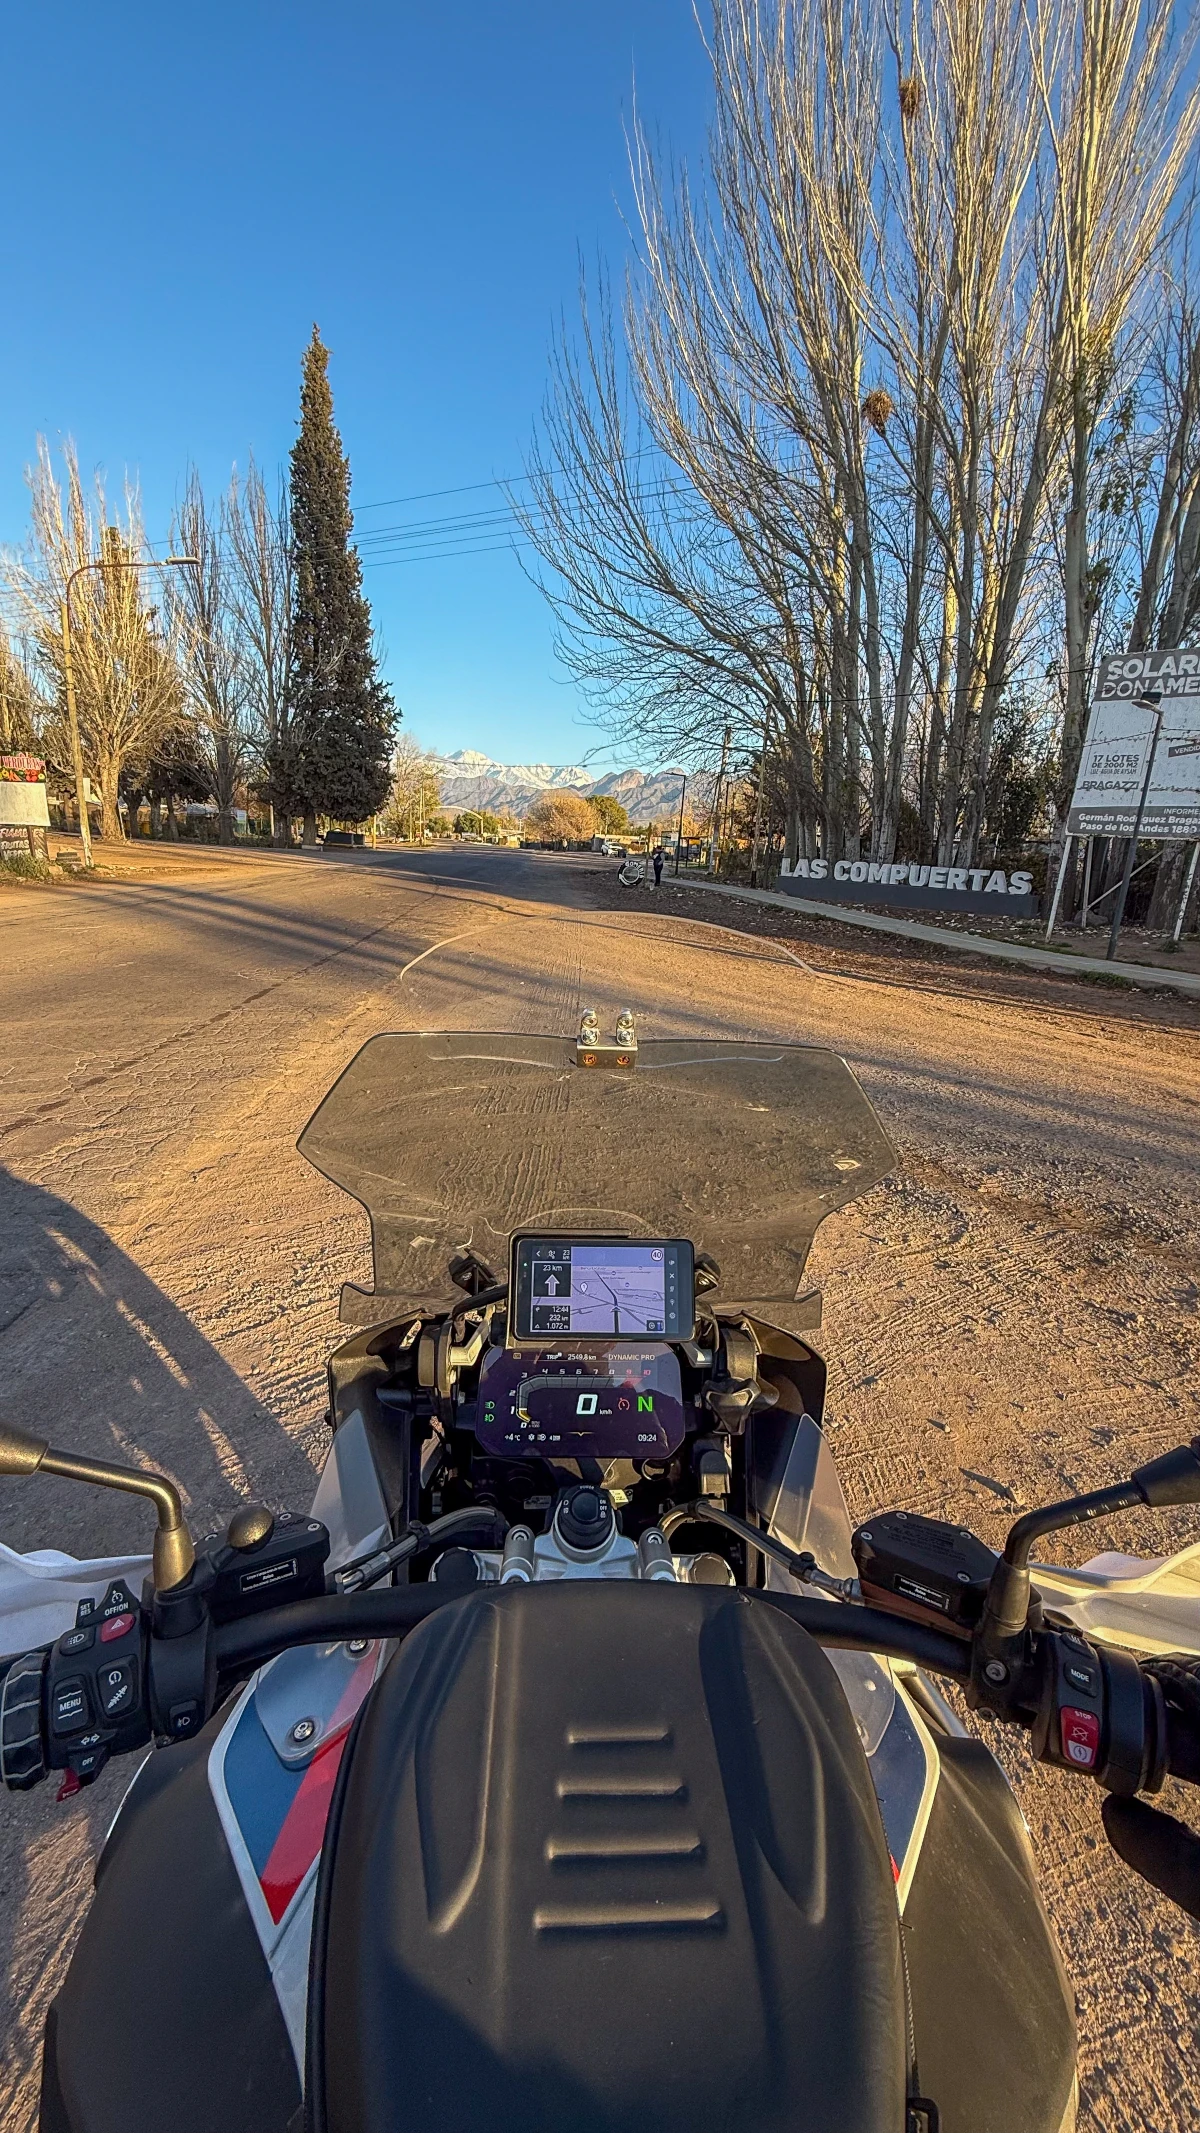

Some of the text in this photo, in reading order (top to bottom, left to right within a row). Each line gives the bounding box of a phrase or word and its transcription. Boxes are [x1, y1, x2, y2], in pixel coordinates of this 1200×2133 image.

[1106, 655, 1200, 680] SOLAR
[1101, 677, 1200, 698] DONAME
[1082, 781, 1139, 790] BRAGAZZI
[1078, 813, 1114, 821] Germán
[1079, 822, 1103, 830] Paso
[1104, 823, 1117, 831] de
[1119, 823, 1135, 832] los
[780, 857, 1033, 895] LAS COMPUERTAS
[608, 1353, 639, 1361] DYNAMIC
[576, 1393, 598, 1415] 0
[637, 1396, 653, 1412] N
[637, 1433, 657, 1442] 09:24
[1071, 1669, 1090, 1682] MODE
[60, 1698, 81, 1711] MENU
[1075, 1711, 1092, 1719] STOP
[82, 1756, 94, 1766] OFF
